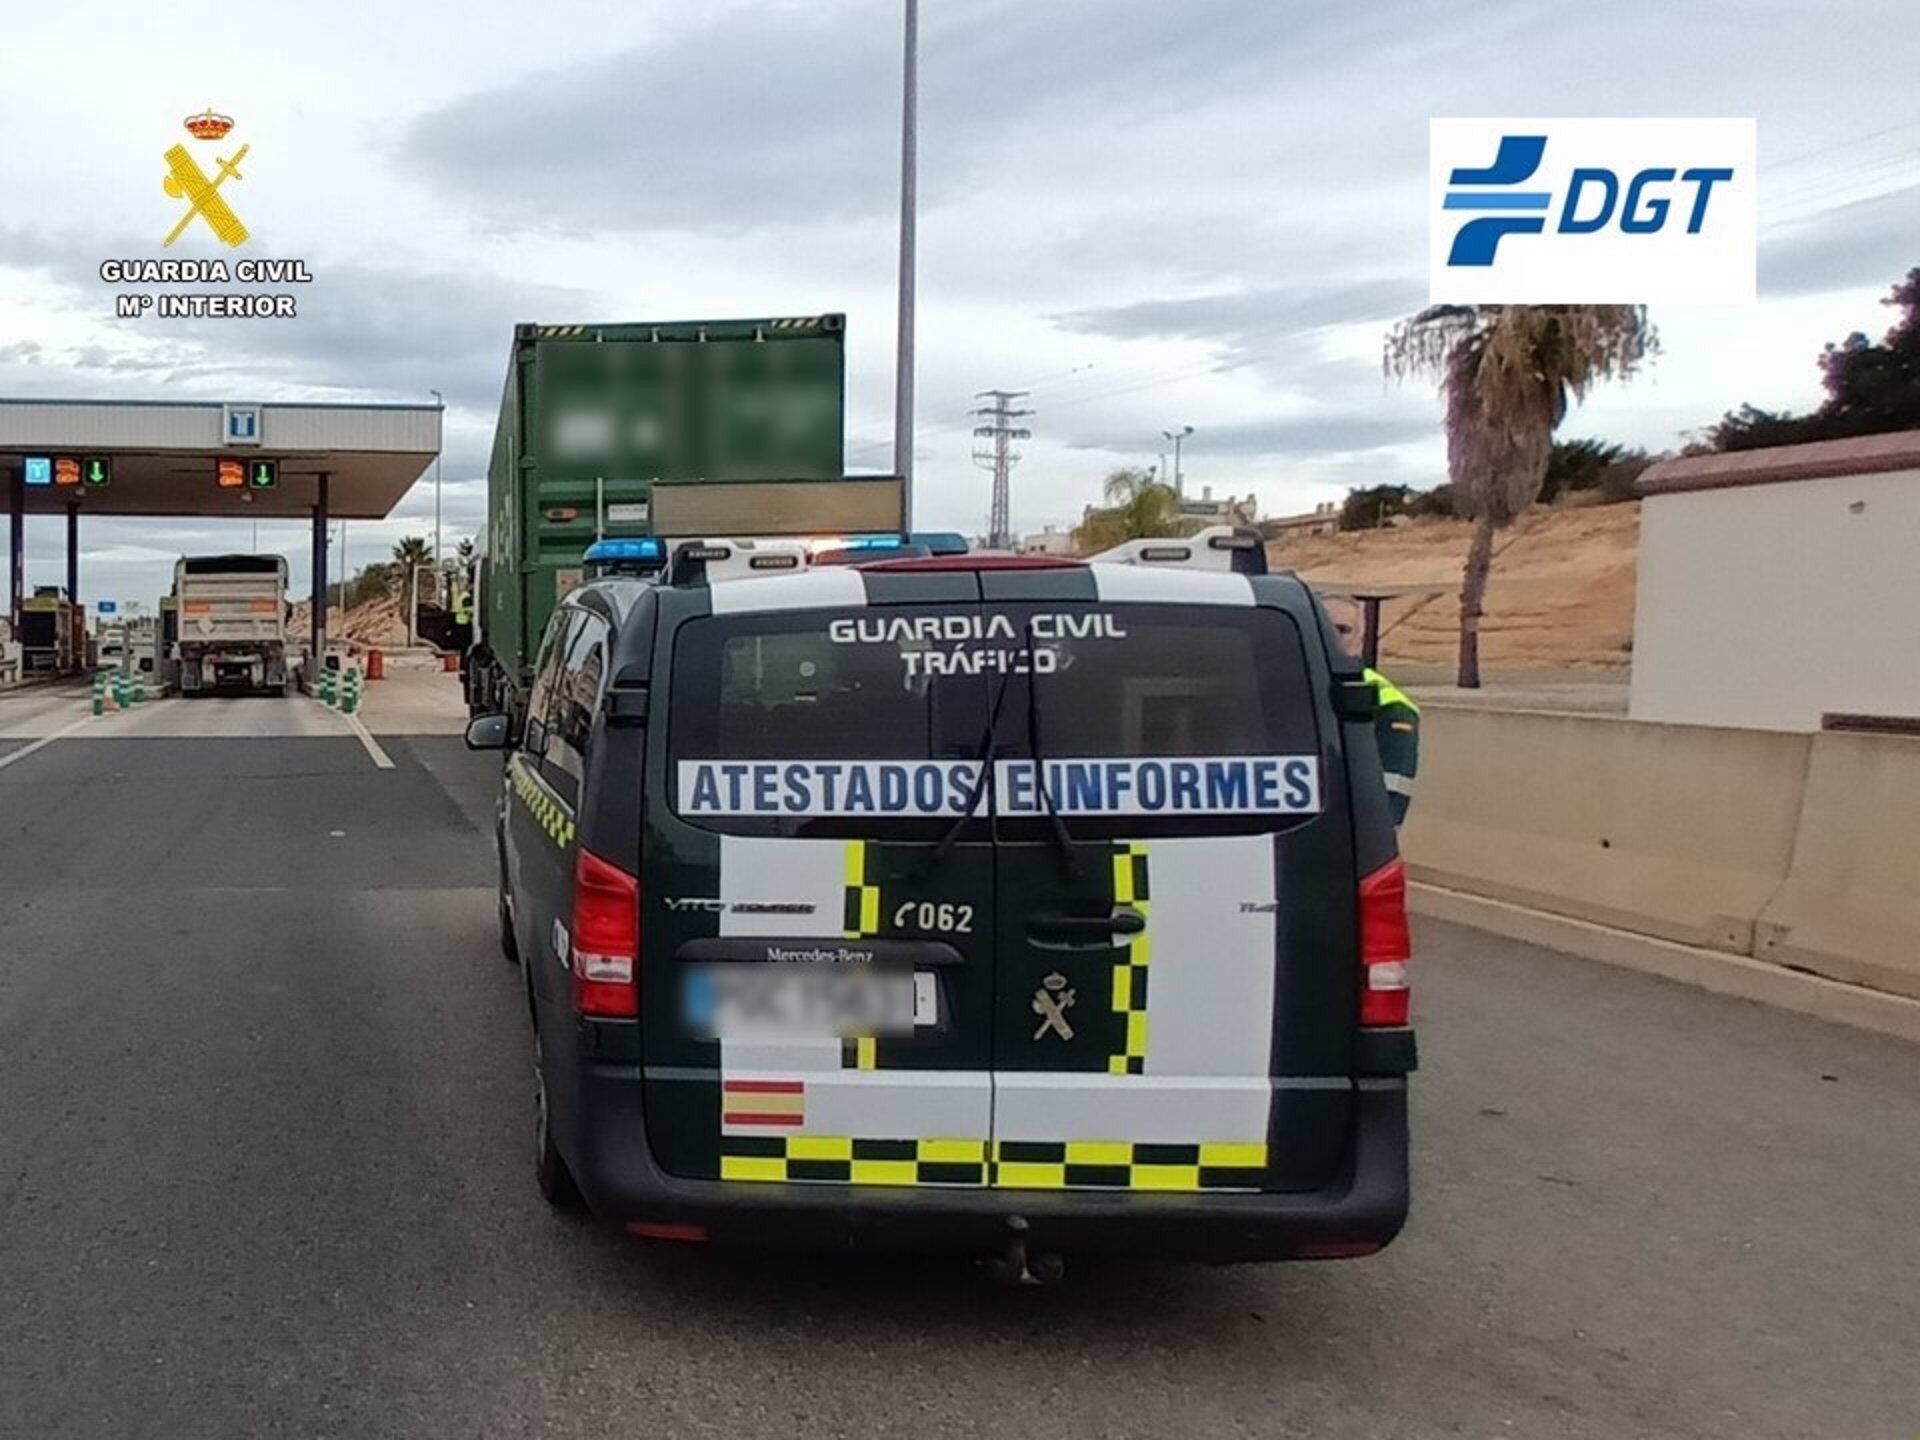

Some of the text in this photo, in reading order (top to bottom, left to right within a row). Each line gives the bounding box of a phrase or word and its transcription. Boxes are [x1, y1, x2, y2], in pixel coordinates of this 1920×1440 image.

[829, 613, 1127, 643] GUARDIA CIVIL
[690, 763, 977, 813] ATESTADOS
[917, 901, 974, 933] 062
[767, 947, 874, 963] Mercedes-Benz
